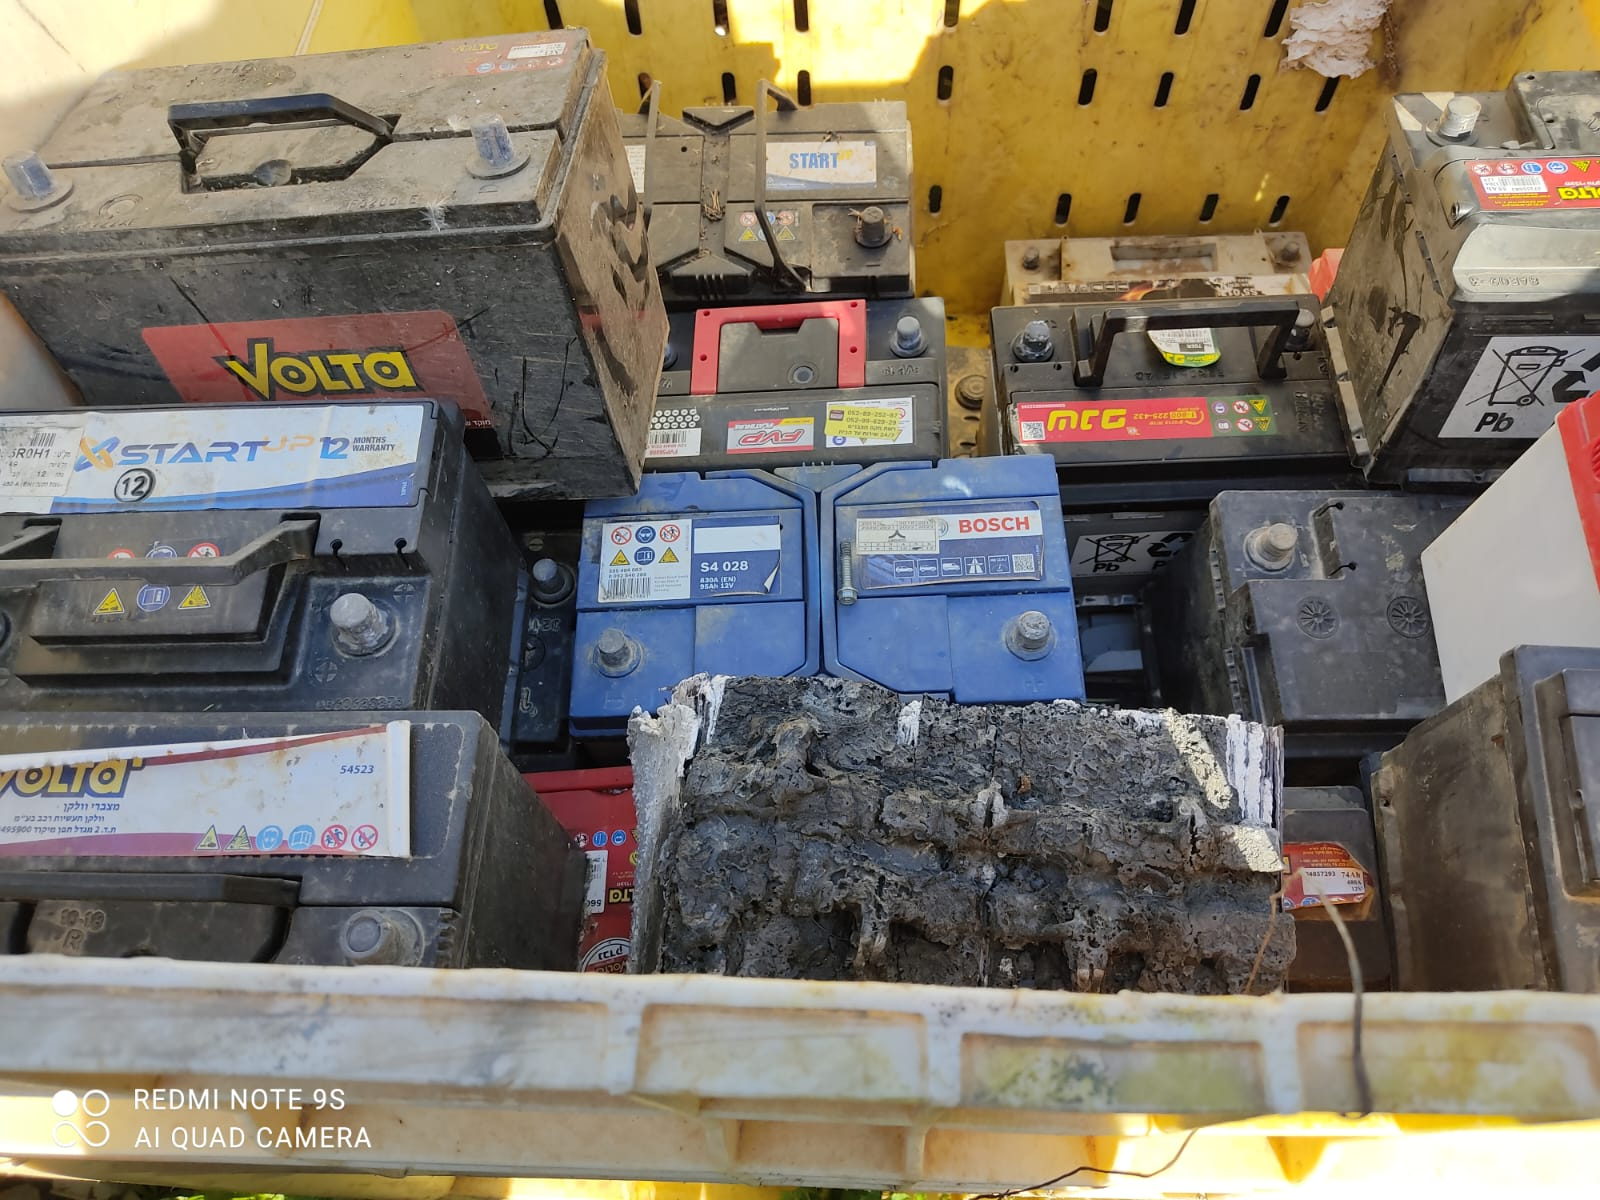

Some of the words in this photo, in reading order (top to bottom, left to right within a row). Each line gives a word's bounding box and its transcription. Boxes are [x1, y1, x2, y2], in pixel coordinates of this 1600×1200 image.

[1474, 412, 1514, 432] Pb
[353, 436, 387, 445] MONTHS
[738, 428, 805, 446] FVP
[319, 436, 350, 460] 12
[352, 443, 396, 452] WARRANTY
[122, 475, 146, 497] 12
[959, 516, 1031, 534] BOSCH
[700, 562, 719, 572] S4
[722, 560, 749, 572] 028
[1092, 562, 1120, 573] Pb
[339, 763, 375, 775] 54523
[62, 801, 89, 813] וולקן
[91, 801, 121, 811] מצברי
[37, 814, 52, 822] רכב
[53, 814, 83, 823] תעשיות
[84, 814, 105, 823] וולקן
[598, 945, 623, 961] נבדק
